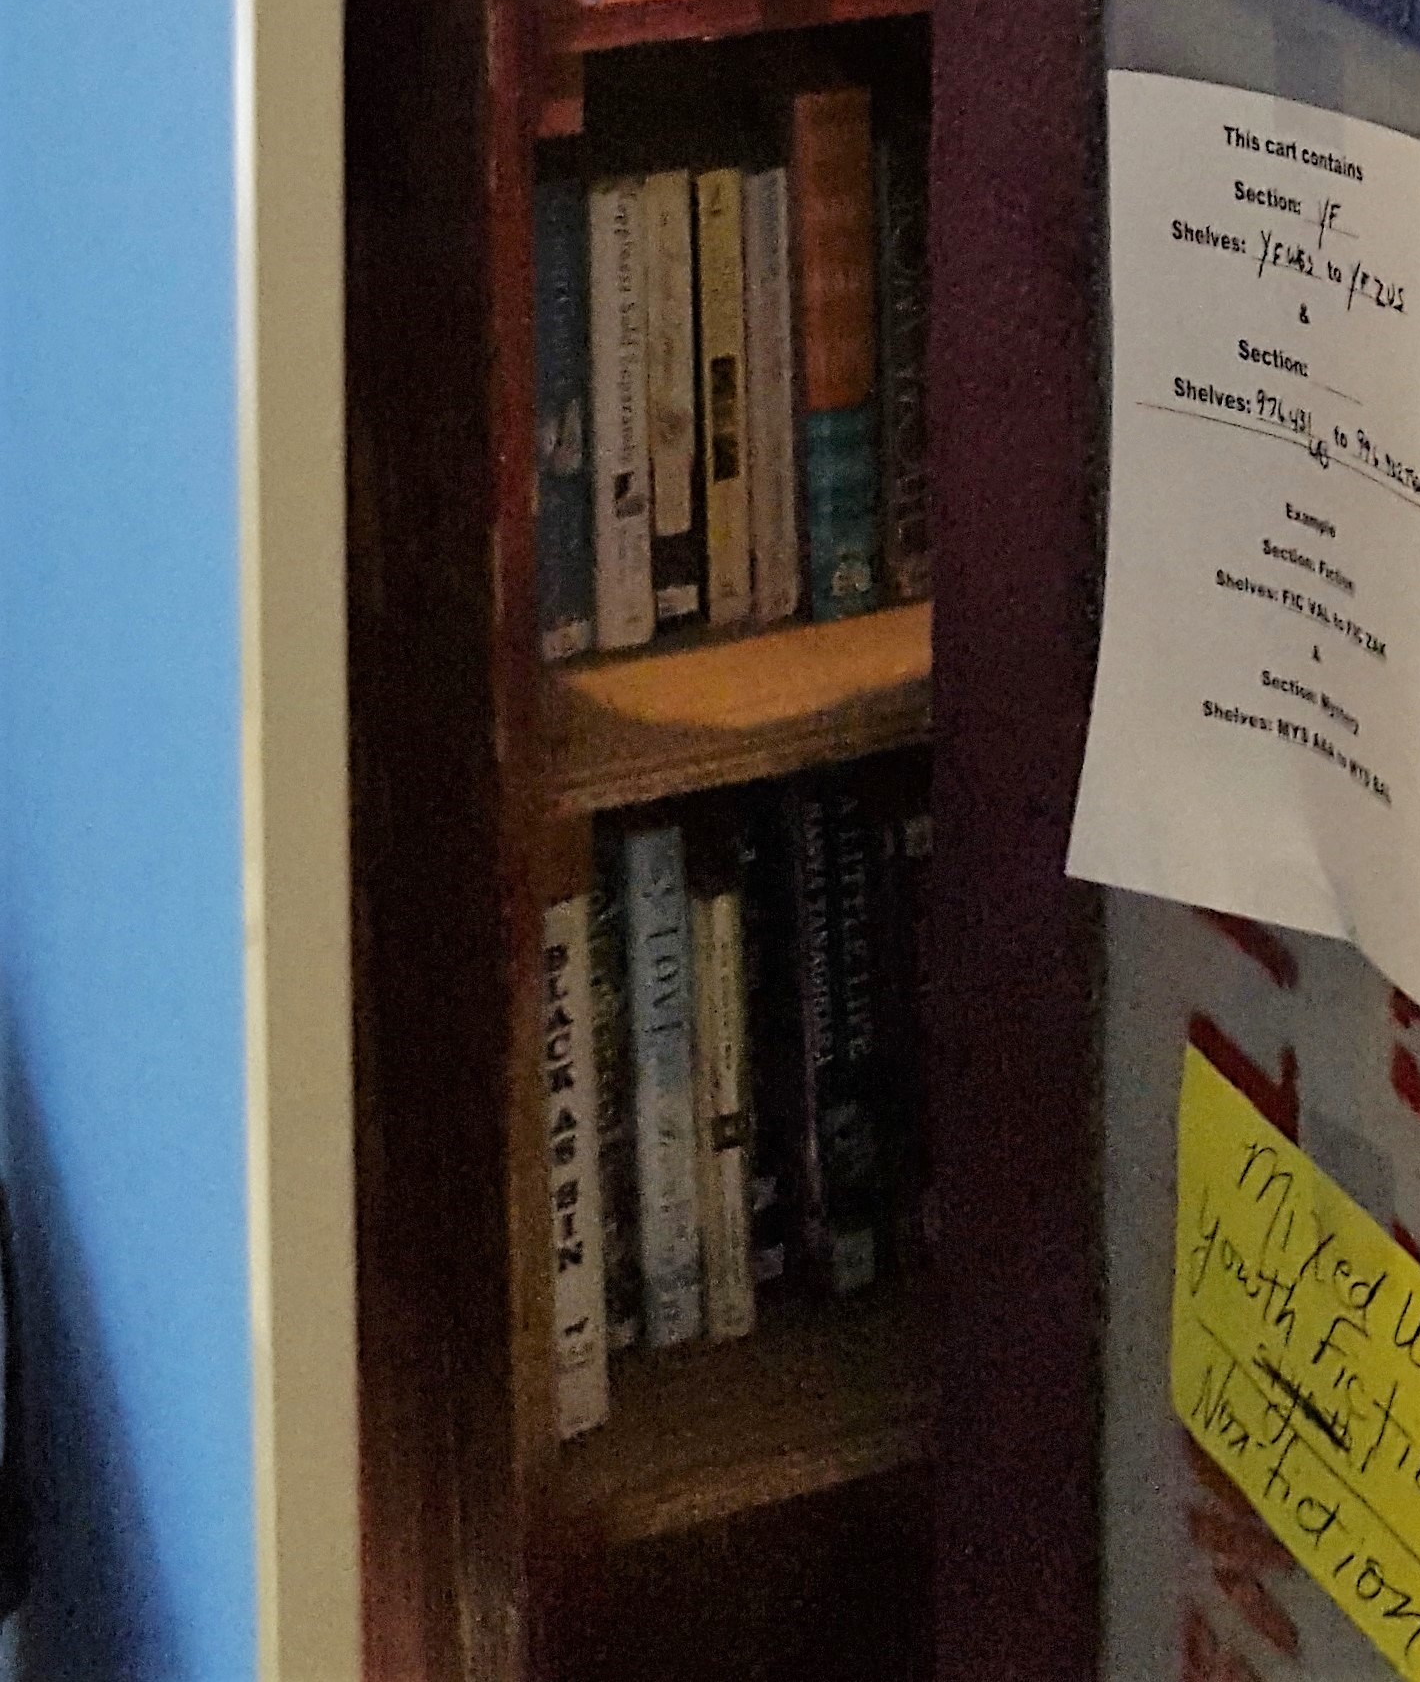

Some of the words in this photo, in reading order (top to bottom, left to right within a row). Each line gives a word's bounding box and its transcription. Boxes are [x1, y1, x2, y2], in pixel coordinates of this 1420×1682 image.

[1223, 124, 1261, 152] This
[1264, 137, 1297, 161] cart
[1301, 145, 1364, 183] contains
[1233, 179, 1301, 216] Section:
[1171, 219, 1247, 254] Shelves:
[1327, 260, 1342, 283] to
[1299, 301, 1310, 325] &
[1237, 337, 1308, 378] Section:
[1173, 376, 1252, 415] Shelves:
[1333, 425, 1348, 449] to
[1285, 501, 1337, 539] Example
[1262, 536, 1316, 573] Section:
[1215, 568, 1279, 603] Shelves:
[1282, 588, 1304, 613] FIC
[1261, 669, 1319, 706] Section:
[1201, 698, 1274, 733] Shelves:
[1277, 717, 1309, 745] MYS
[547, 942, 574, 1095] BLACK
